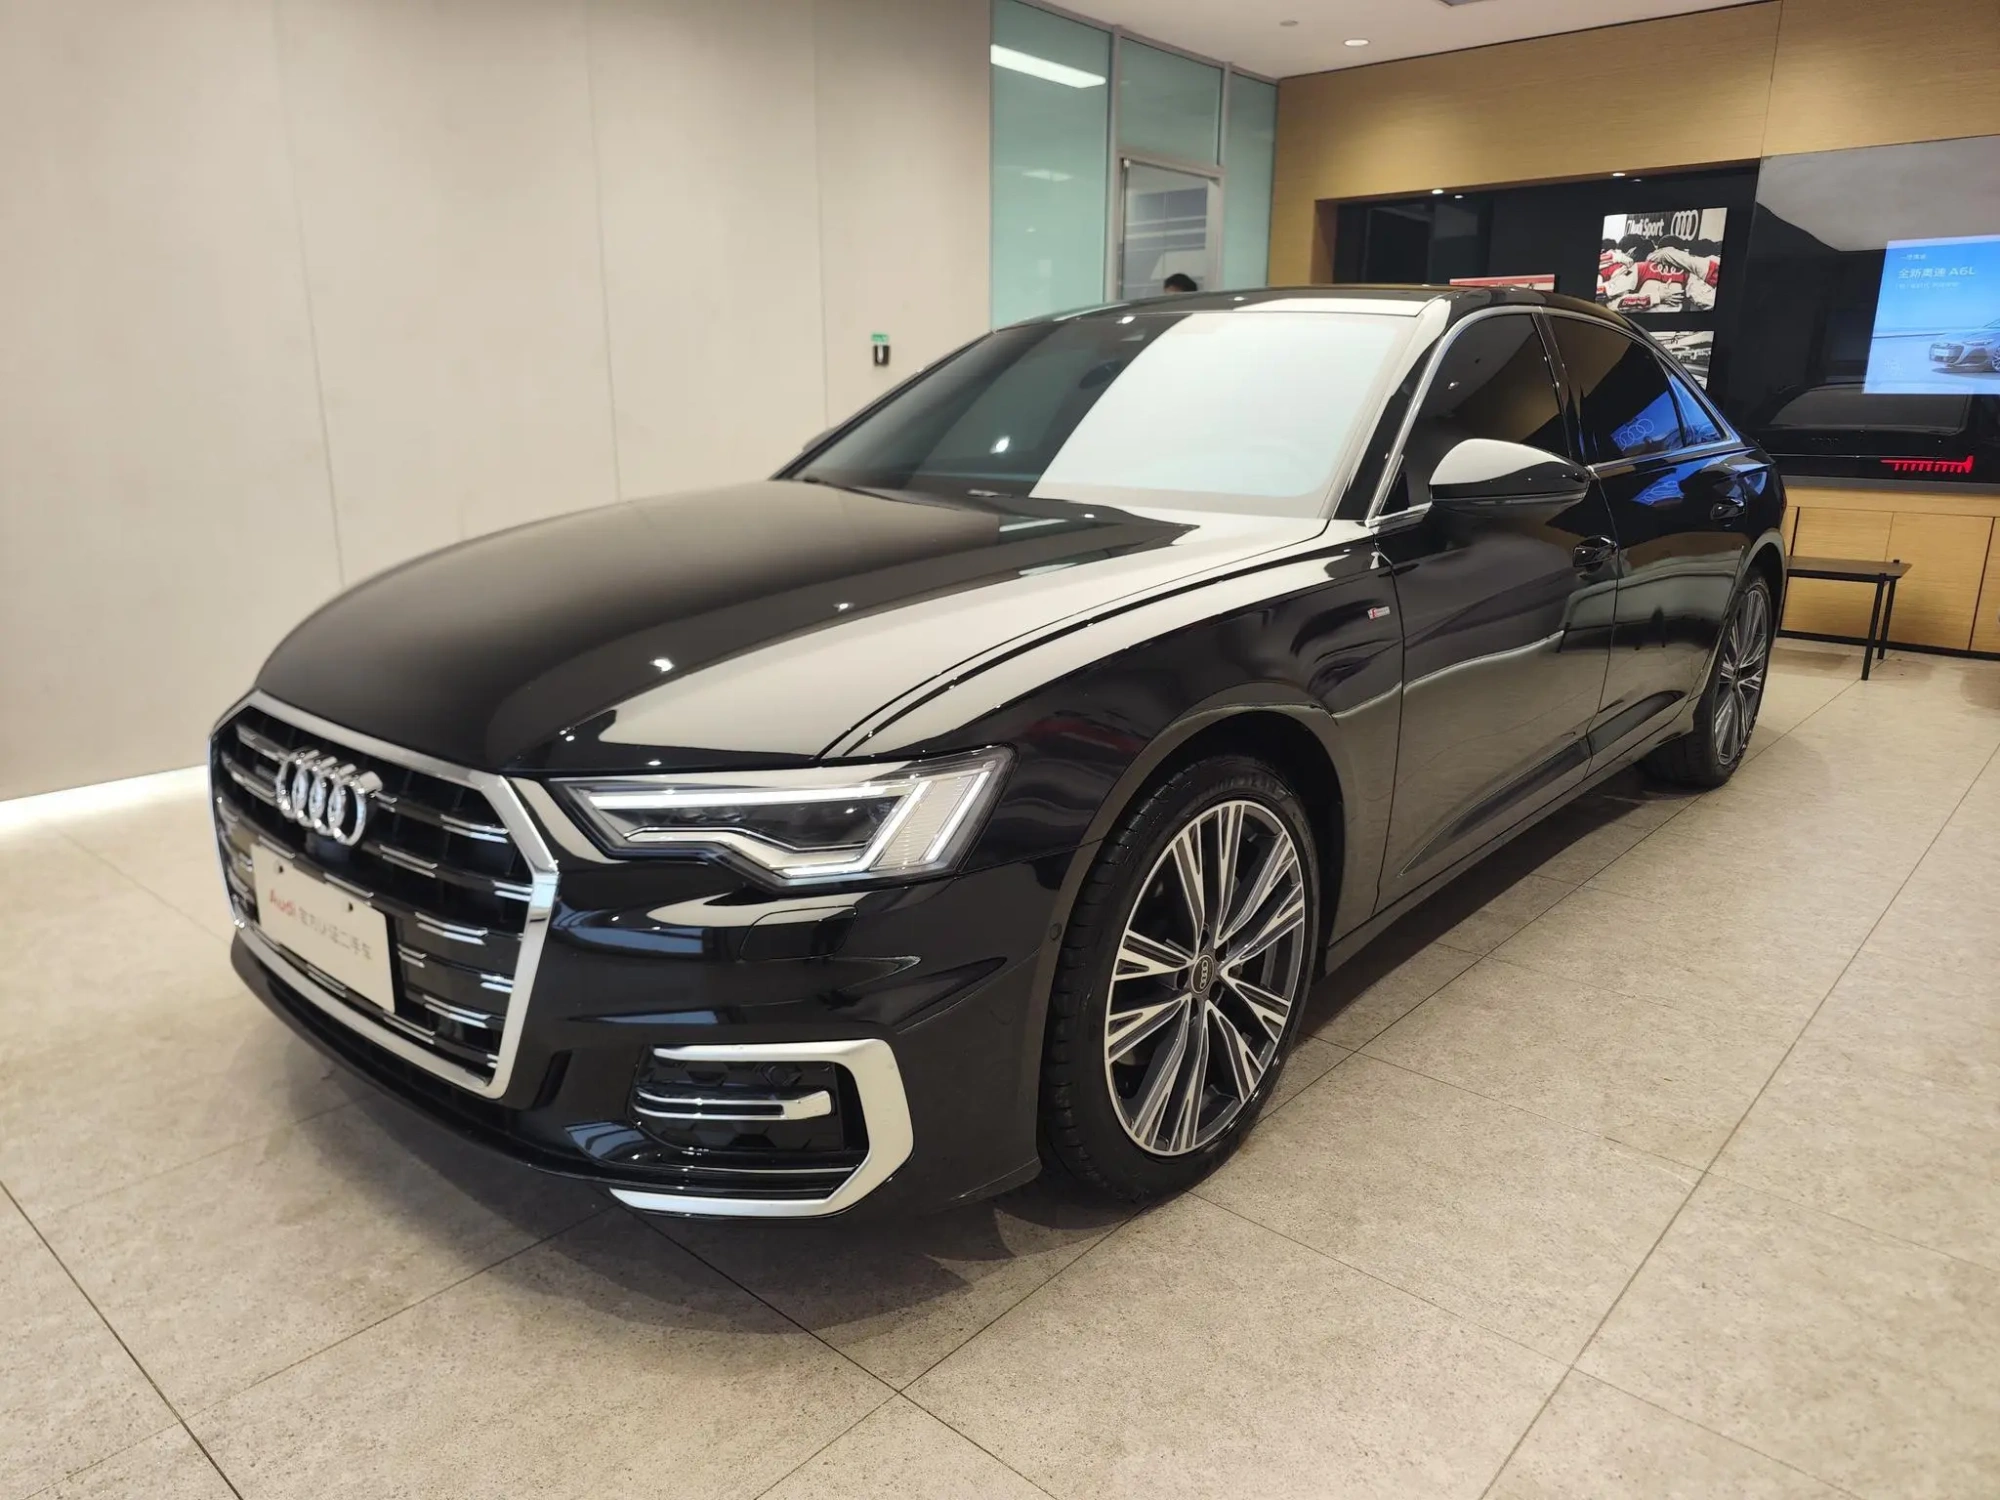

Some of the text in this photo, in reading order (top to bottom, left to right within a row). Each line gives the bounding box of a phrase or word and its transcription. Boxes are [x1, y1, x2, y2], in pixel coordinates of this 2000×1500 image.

[1625, 218, 1664, 239] Audi Sport
[1948, 266, 1976, 276] A6L
